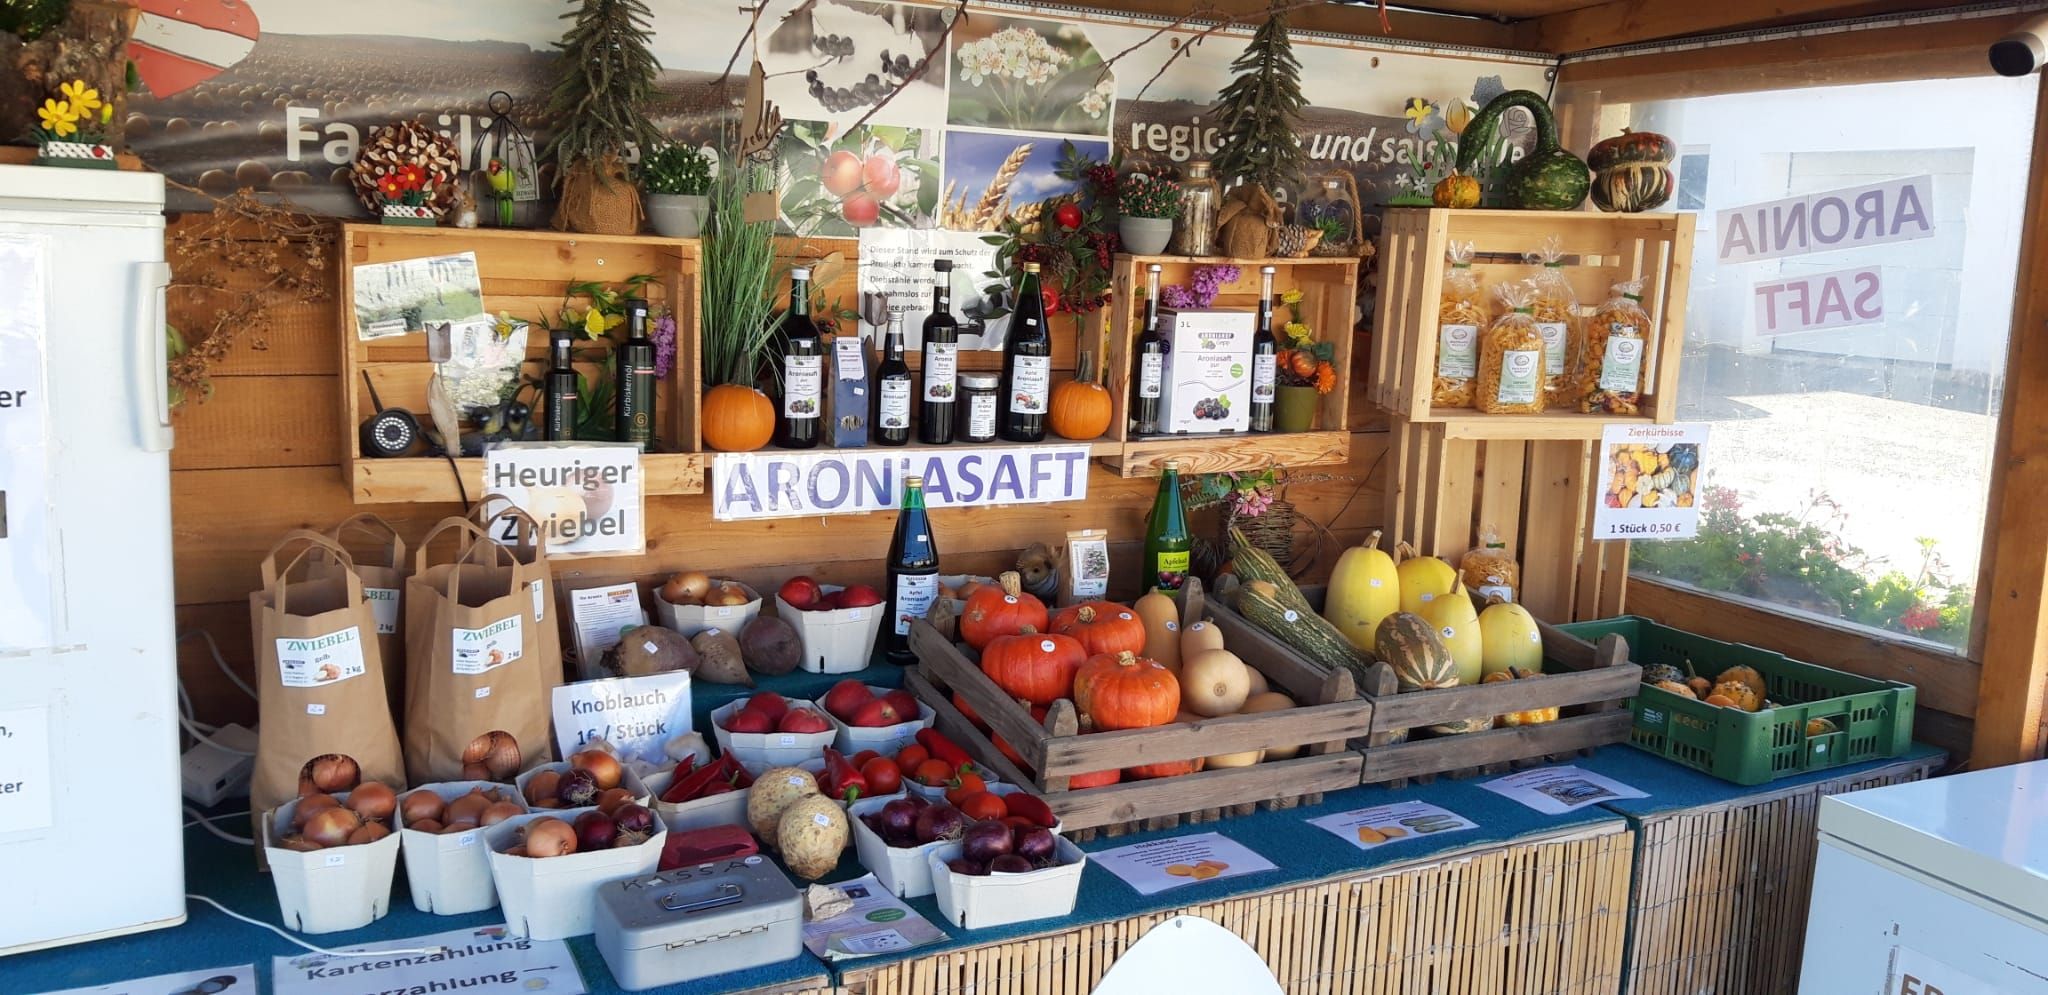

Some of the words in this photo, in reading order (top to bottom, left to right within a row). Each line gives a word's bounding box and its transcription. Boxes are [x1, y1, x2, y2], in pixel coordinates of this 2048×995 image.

[1310, 127, 1378, 162] und
[897, 246, 919, 255] Stand
[920, 247, 937, 255] wird
[955, 247, 977, 257] Schutz
[1197, 354, 1232, 362] Aroniasaft
[1628, 427, 1684, 440] Zierkürbisse
[494, 460, 633, 491] Heuriger
[718, 452, 1085, 513] ARONIASAFT
[1610, 525, 1616, 533] 1
[1619, 523, 1648, 534] Stück
[1650, 523, 1673, 535] 0,50
[1674, 523, 1681, 533] €
[900, 595, 929, 603] Aroniasaft
[463, 618, 518, 642] ZWIEBEL
[286, 631, 355, 651] ZWIEBEL
[352, 665, 362, 673] kg
[571, 688, 666, 716] Knoblauch
[616, 719, 667, 740] Stück
[621, 860, 751, 892] KASSA
[306, 938, 533, 981] Kartenzahlung
